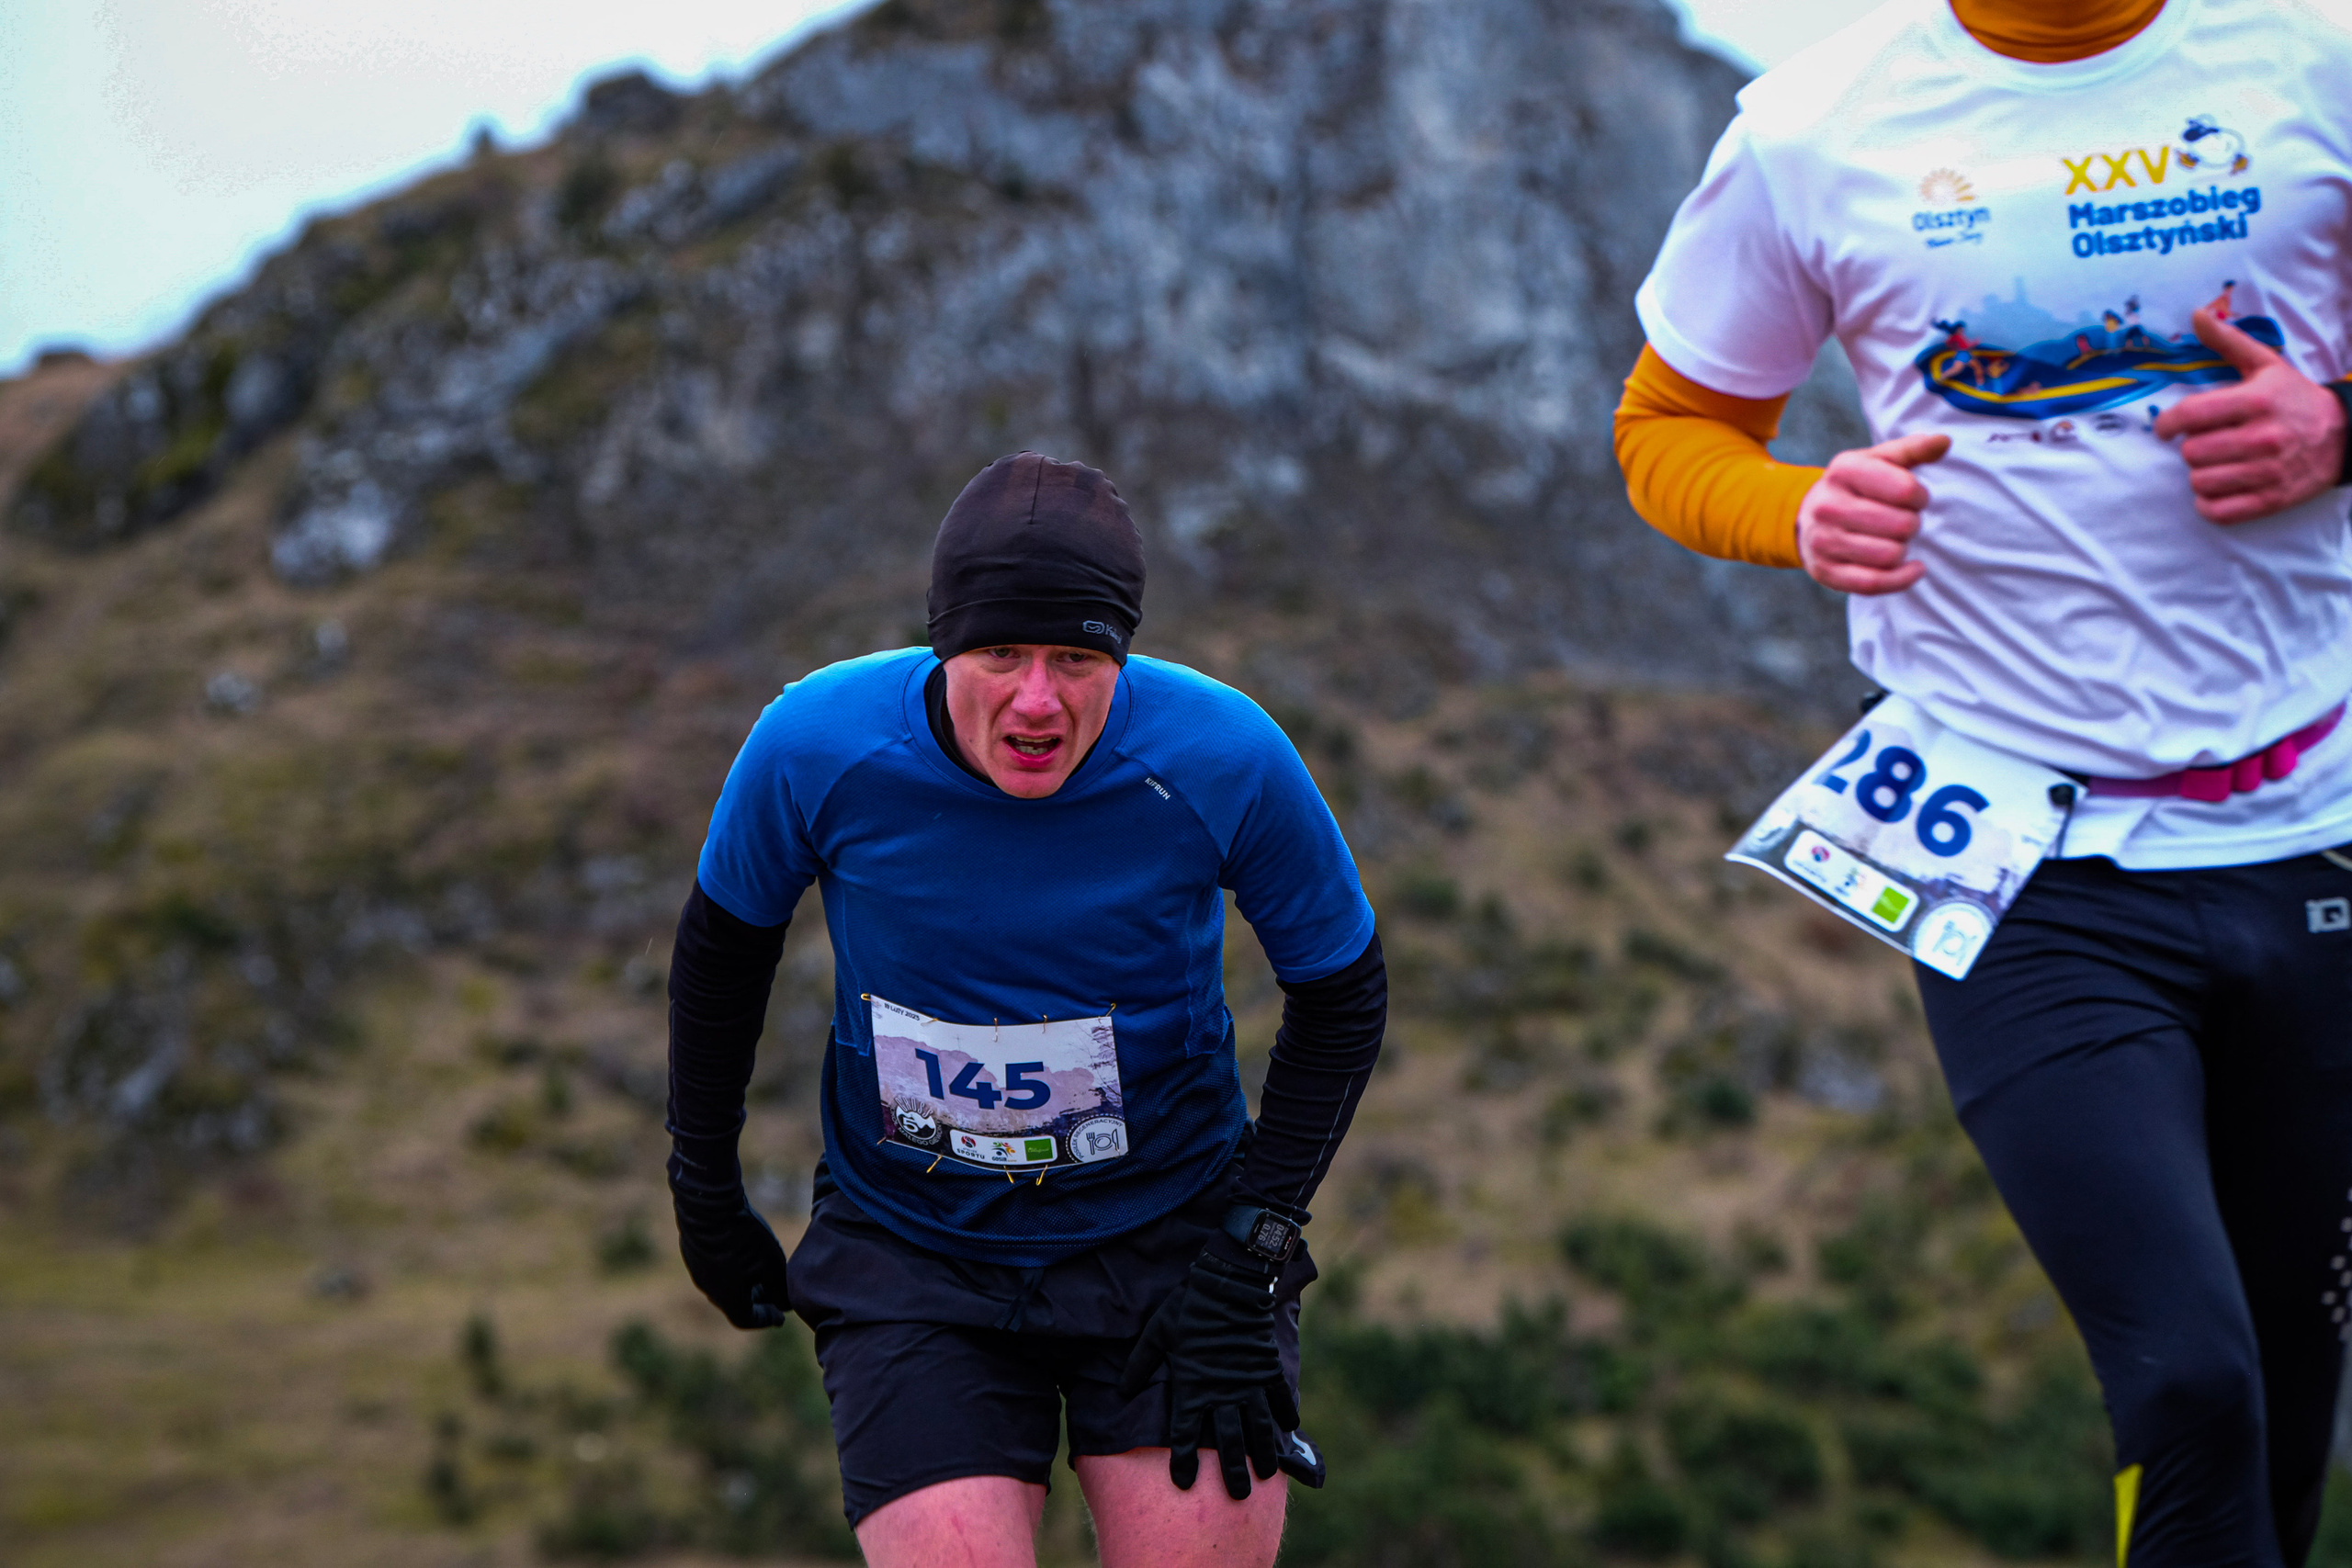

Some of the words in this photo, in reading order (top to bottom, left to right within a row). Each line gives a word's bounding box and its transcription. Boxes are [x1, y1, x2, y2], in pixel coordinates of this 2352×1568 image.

[2063, 145, 2169, 196] XXV
[2068, 186, 2261, 229] Marszobieg
[2072, 211, 2248, 258] Olsztyński
[1145, 777, 1170, 800] KIFRUN
[1812, 728, 1990, 858] 286
[915, 1048, 1051, 1111] 145
[956, 1148, 985, 1160] SPORTU
